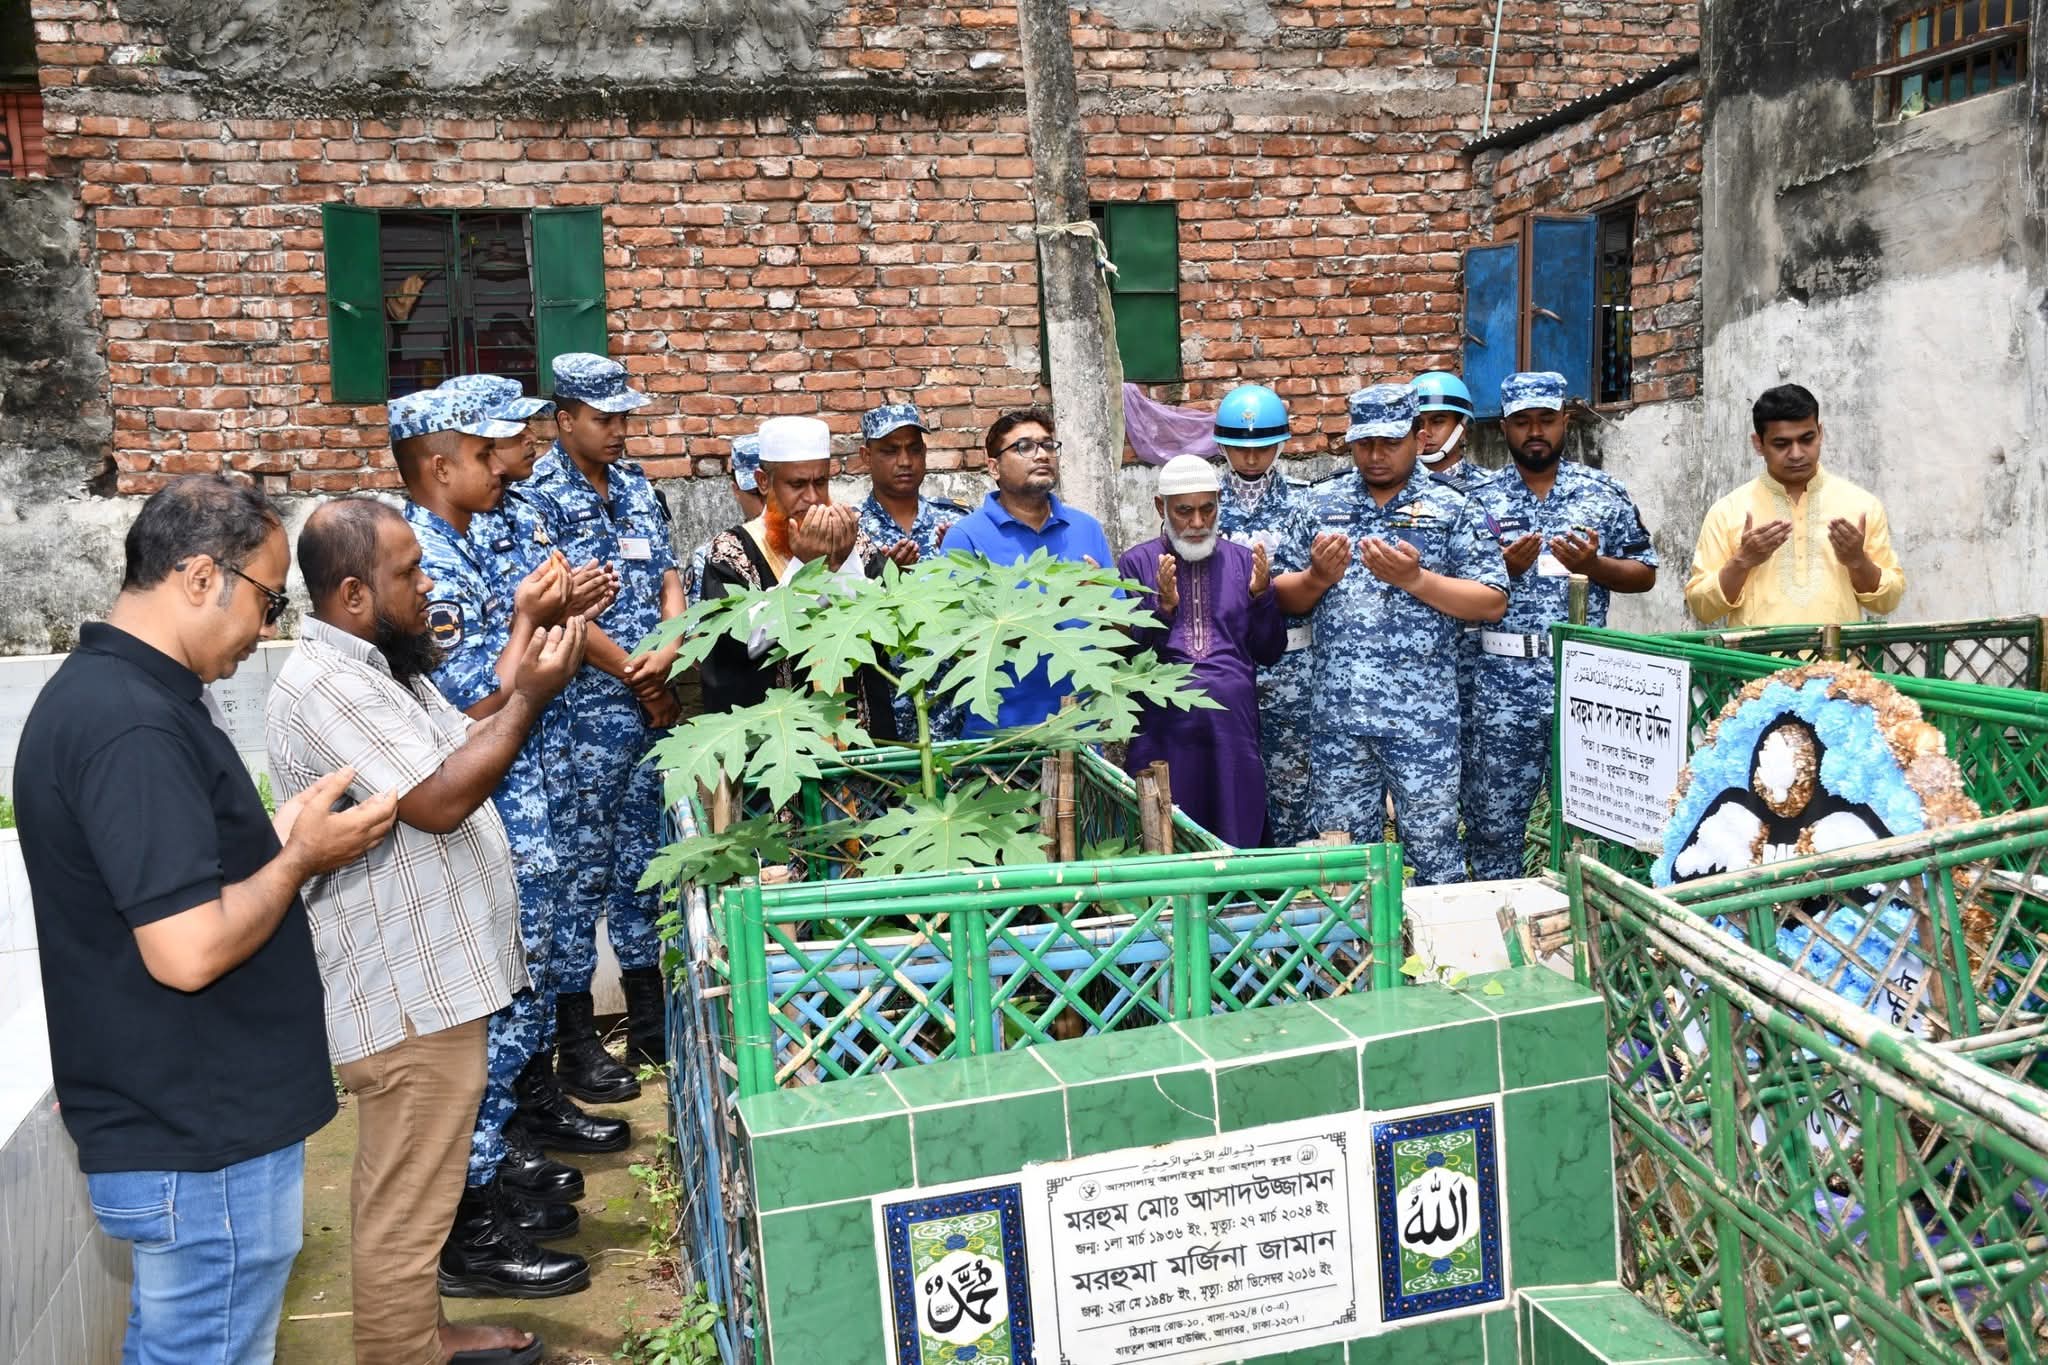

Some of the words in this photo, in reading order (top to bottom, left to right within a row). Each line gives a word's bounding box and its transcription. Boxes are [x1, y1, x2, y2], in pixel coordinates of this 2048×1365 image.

[1570, 696, 1594, 735] মরহুম
[1596, 702, 1613, 736] সাদ
[1615, 706, 1642, 744] সালাহ
[1064, 1203, 1128, 1232] মরহুম
[1138, 1195, 1179, 1221] মোঃ
[1126, 1229, 1145, 1247] মার্চ
[1150, 1228, 1183, 1244] ১৯৩৬
[1240, 1215, 1256, 1229] ২৭
[1259, 1206, 1277, 1224] মার্চ
[1282, 1205, 1312, 1221] ২০২৪
[1315, 1200, 1330, 1214] ইং
[1071, 1260, 1158, 1292] মরহুমা
[1166, 1241, 1248, 1276] মর্জিনা
[1256, 1230, 1337, 1260] জামান
[1145, 1293, 1175, 1308] ১৯৪৮
[1287, 1267, 1317, 1283] ২০১৬
[1319, 1261, 1334, 1276] ইং
